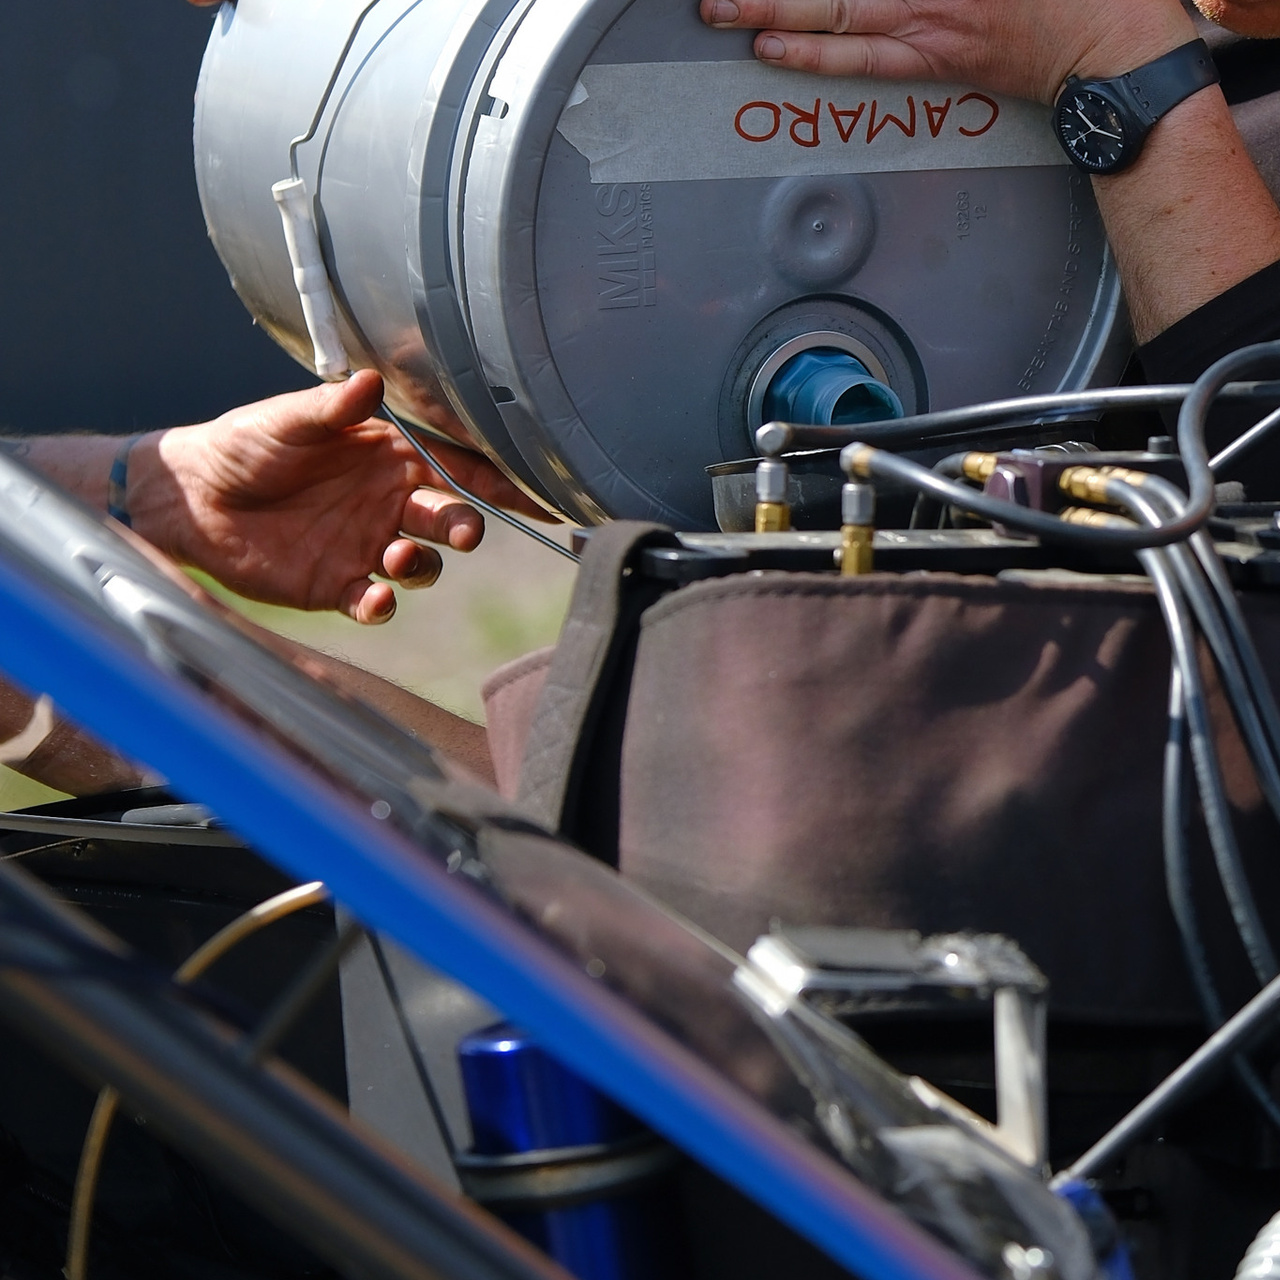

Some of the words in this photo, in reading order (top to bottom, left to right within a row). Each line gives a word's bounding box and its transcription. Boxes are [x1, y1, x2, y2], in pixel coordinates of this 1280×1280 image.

[733, 92, 1000, 147] CAMARO
[639, 183, 655, 248] PLASTICS
[1066, 202, 1083, 256] STRIP
[595, 183, 639, 310] MKS
[1059, 260, 1078, 297] AND
[1047, 300, 1070, 331] TAB
[1017, 334, 1056, 391] BREAK
